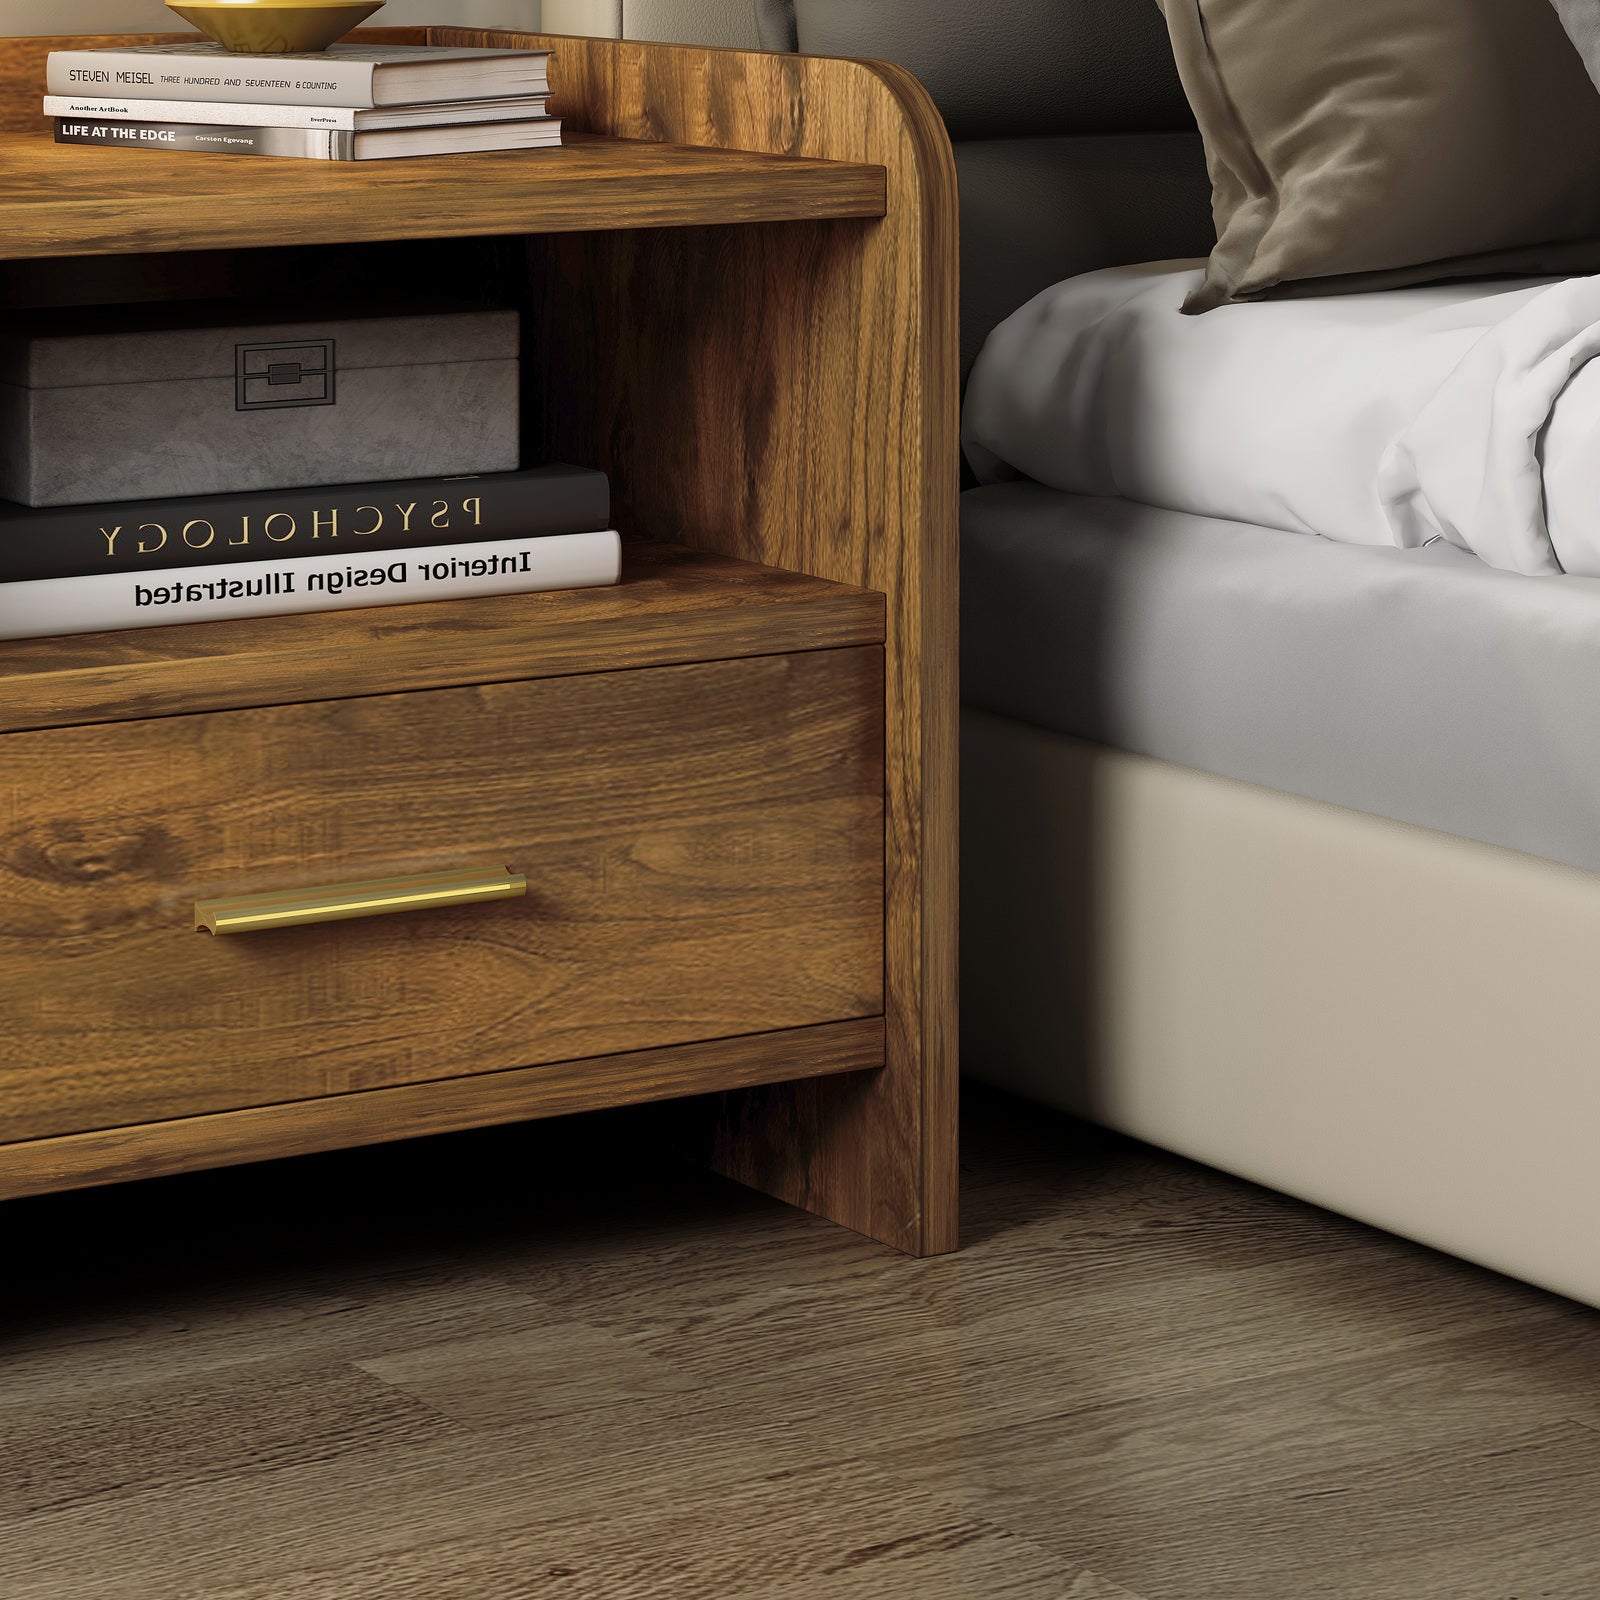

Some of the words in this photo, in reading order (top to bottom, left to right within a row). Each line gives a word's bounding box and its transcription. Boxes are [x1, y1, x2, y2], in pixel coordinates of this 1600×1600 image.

[69, 69, 109, 82] STEVEN
[116, 71, 154, 85] MEISEL
[160, 75, 181, 84] THREE
[183, 77, 221, 86] HUNDRED
[223, 78, 242, 87] AND
[245, 79, 291, 89] SEVENTEEN
[302, 81, 337, 90] COUNTING
[62, 124, 89, 137] LIFE
[91, 126, 109, 138] AT
[110, 127, 137, 140] THE
[139, 129, 176, 142] EDGE
[195, 135, 222, 143] Carsten
[223, 136, 254, 145] Egevang
